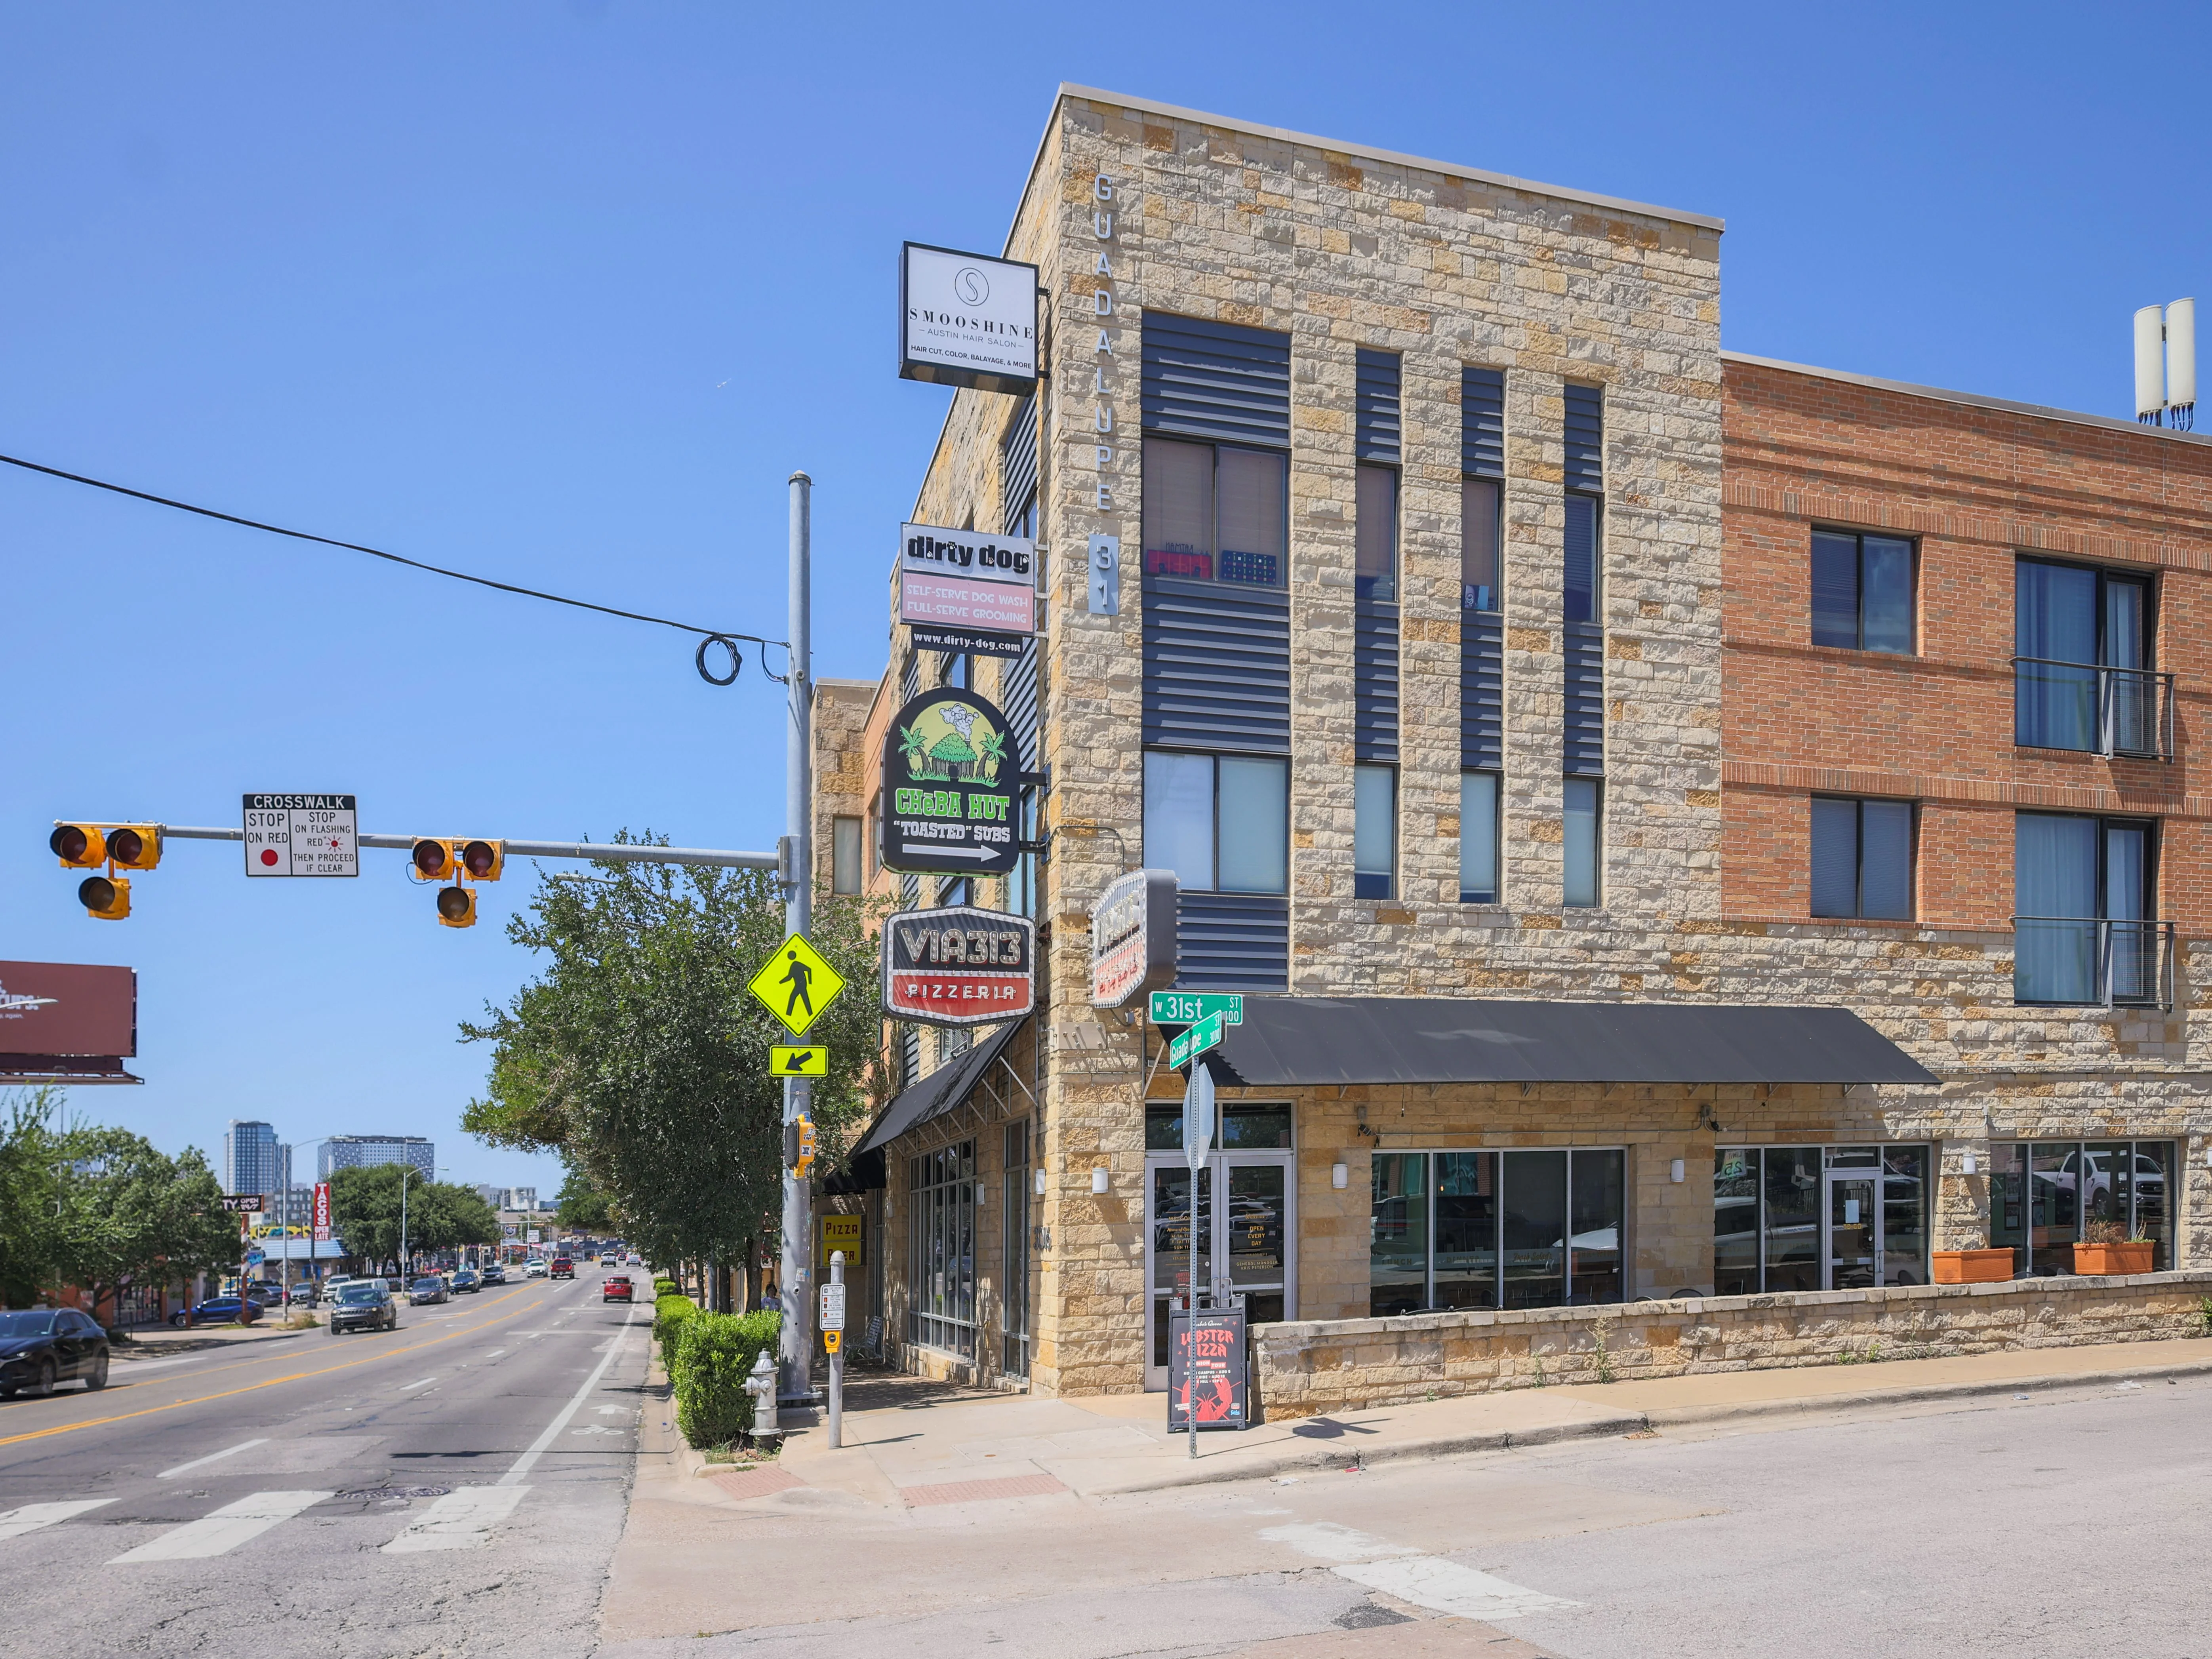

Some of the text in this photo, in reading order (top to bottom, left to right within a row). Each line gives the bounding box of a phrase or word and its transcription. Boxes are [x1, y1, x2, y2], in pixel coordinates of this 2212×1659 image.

[909, 308, 1033, 339] SMOOSHINE
[927, 328, 1016, 348] AUSTIN HAIR SALON
[928, 347, 943, 356] CUT,
[945, 350, 969, 360] COLOR,
[970, 354, 1006, 365] BALAYAGE,
[1013, 360, 1031, 369] MORE
[1095, 173, 1112, 606] GUADALUPE 31
[908, 535, 1029, 573] dirty dog
[907, 585, 1028, 607] SELF-SERVE DOG WASH
[907, 602, 1027, 623] FULL-SERVE GROOMING
[914, 633, 1021, 652] www.dirty-dog.com
[253, 796, 345, 809] CROSSWALK
[968, 794, 1010, 821] HUT
[249, 813, 285, 827] STOP
[309, 812, 335, 823] STOP
[248, 832, 288, 843] ON RED
[295, 825, 351, 833] ON FLASHING
[974, 825, 1010, 843] SUBS
[307, 838, 322, 846] RED
[907, 984, 1016, 1000] PIZZERIA
[1155, 996, 1239, 1019] W 31st ST
[1226, 1011, 1239, 1022] 00
[1215, 1014, 1220, 1027] ST
[1210, 1028, 1220, 1044] 3000
[1171, 1032, 1202, 1063] Guadalupe
[317, 1183, 327, 1226] TACOS
[826, 1222, 858, 1235] PIZZA
[828, 1248, 855, 1261] BER
